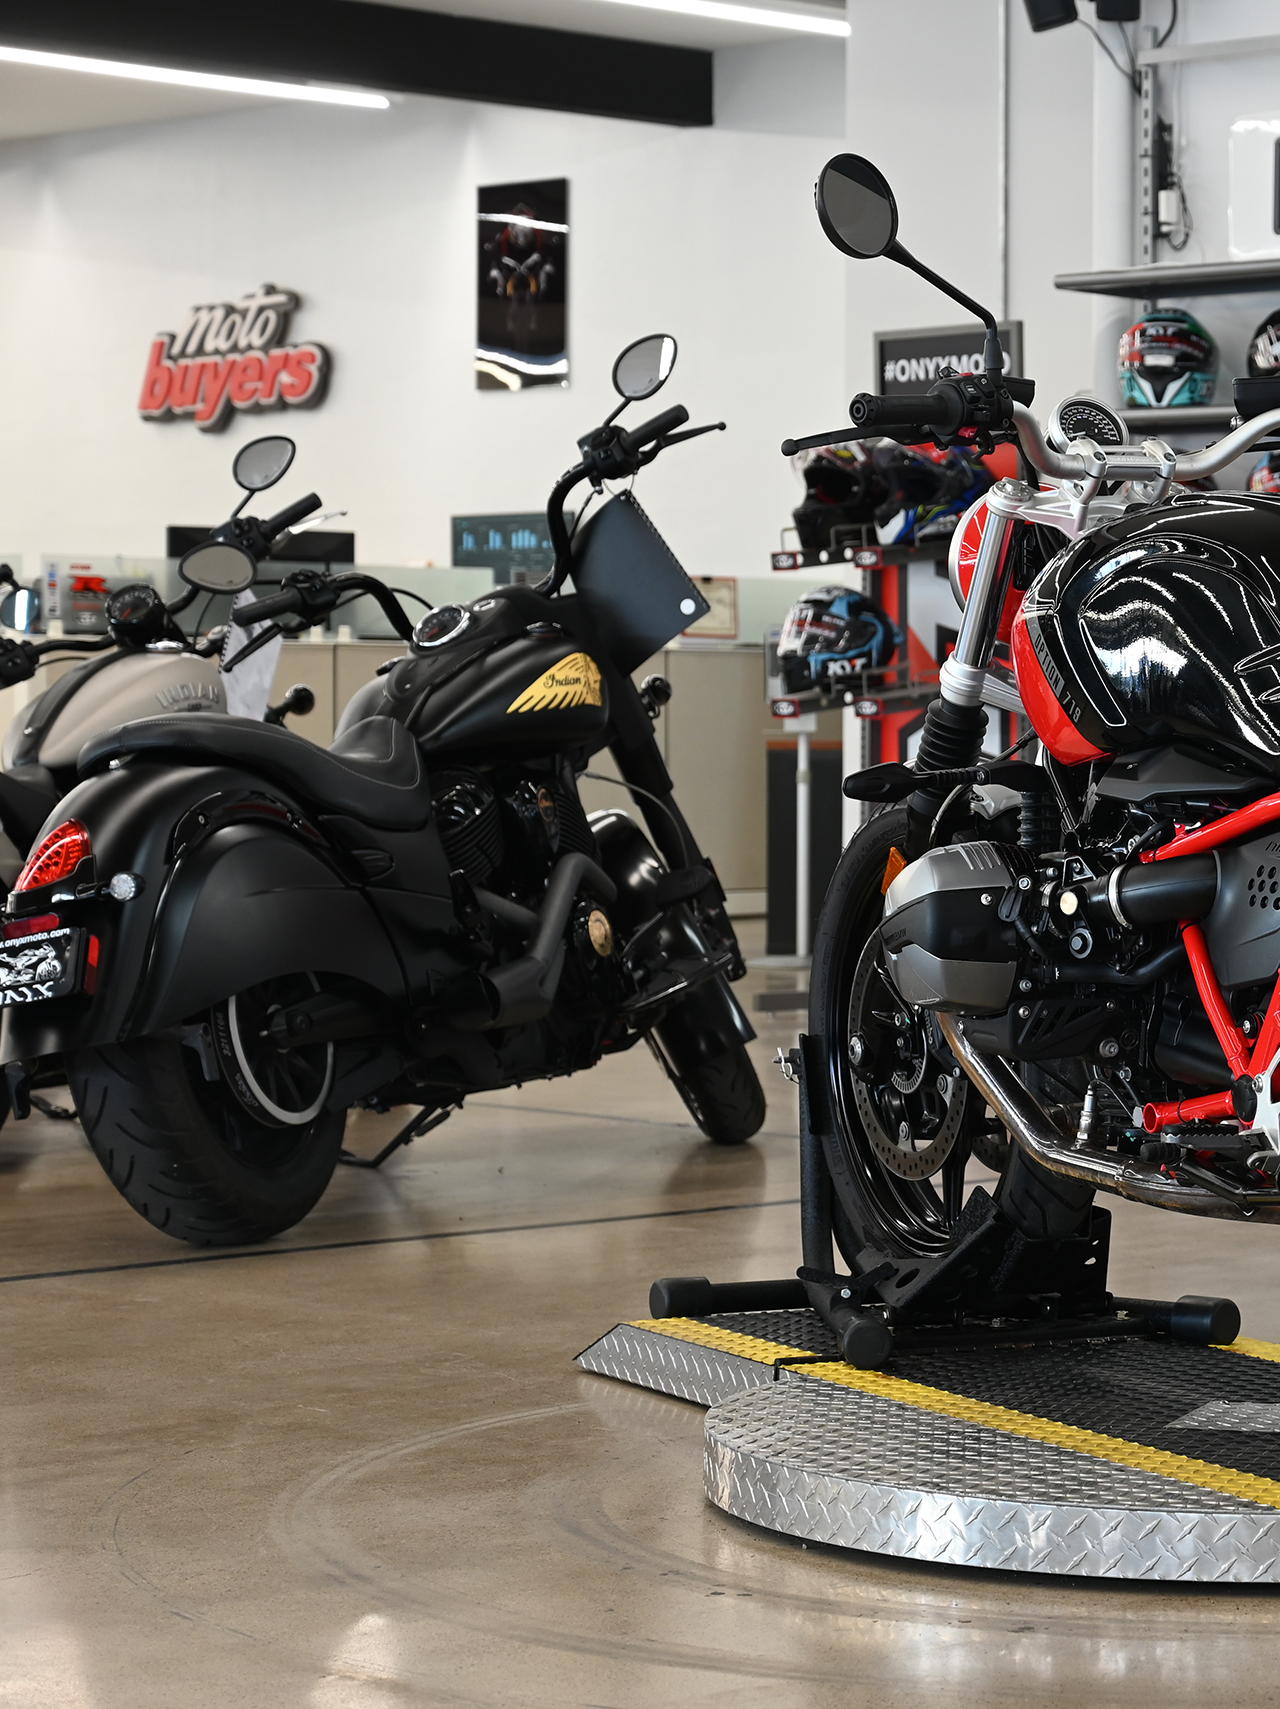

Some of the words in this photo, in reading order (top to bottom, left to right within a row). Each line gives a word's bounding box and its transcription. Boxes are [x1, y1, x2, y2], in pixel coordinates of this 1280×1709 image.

[139, 335, 321, 426] buyers
[883, 351, 1011, 382] #ONYXMOO
[543, 673, 581, 689] Indian
[826, 658, 868, 675] KYT
[1034, 634, 1061, 691] OPTION
[1062, 690, 1081, 723] 719
[924, 1008, 934, 1045] embo
